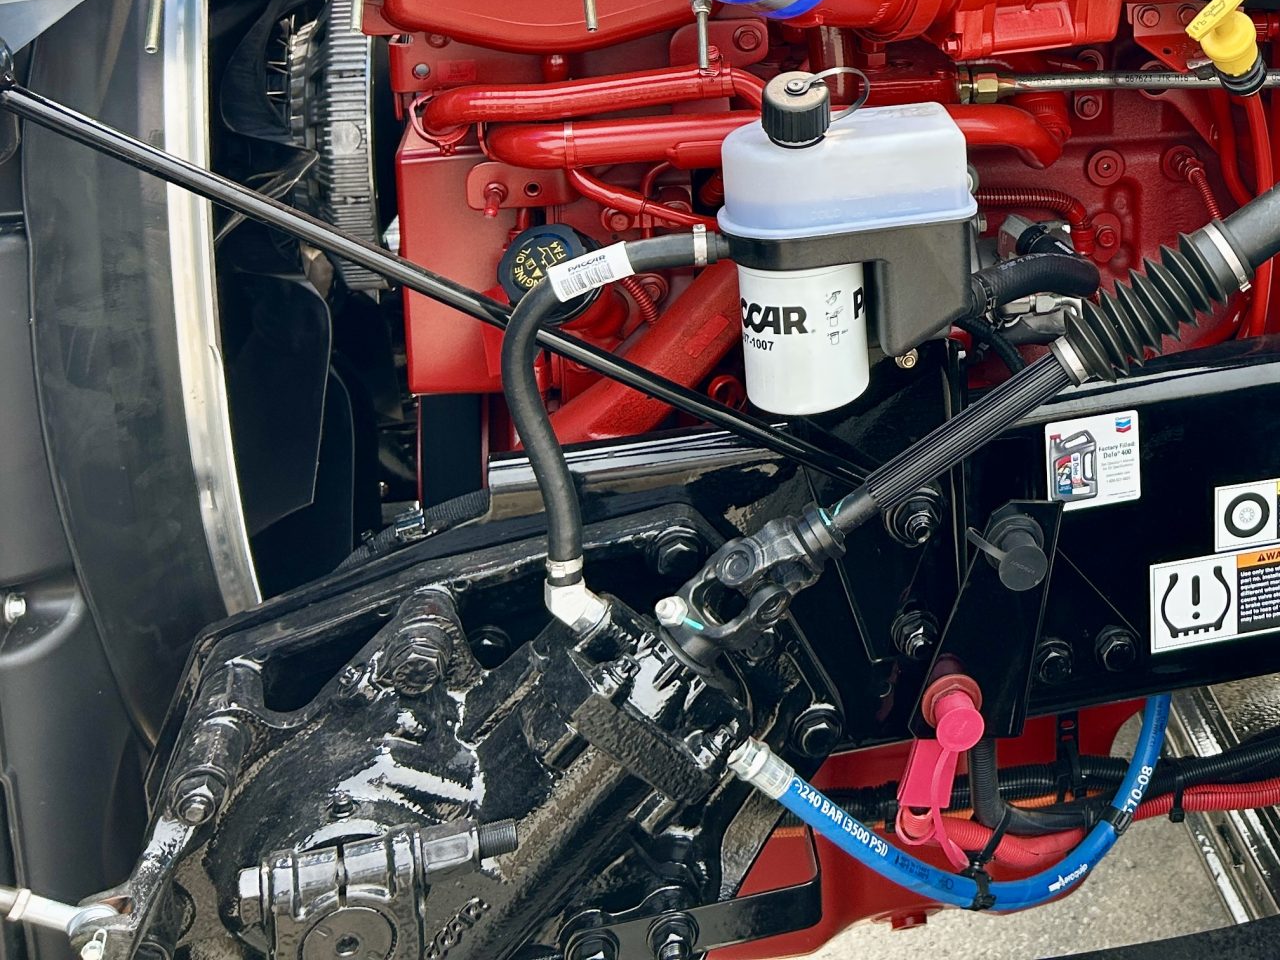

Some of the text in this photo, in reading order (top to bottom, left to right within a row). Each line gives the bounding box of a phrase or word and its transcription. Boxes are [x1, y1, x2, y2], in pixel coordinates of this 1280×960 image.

[516, 248, 531, 263] OIL
[550, 241, 566, 259] FA4
[568, 255, 606, 273] PACCAR
[741, 297, 808, 334] CCAR
[800, 785, 888, 856] 240 BAR (3500 PSI)
